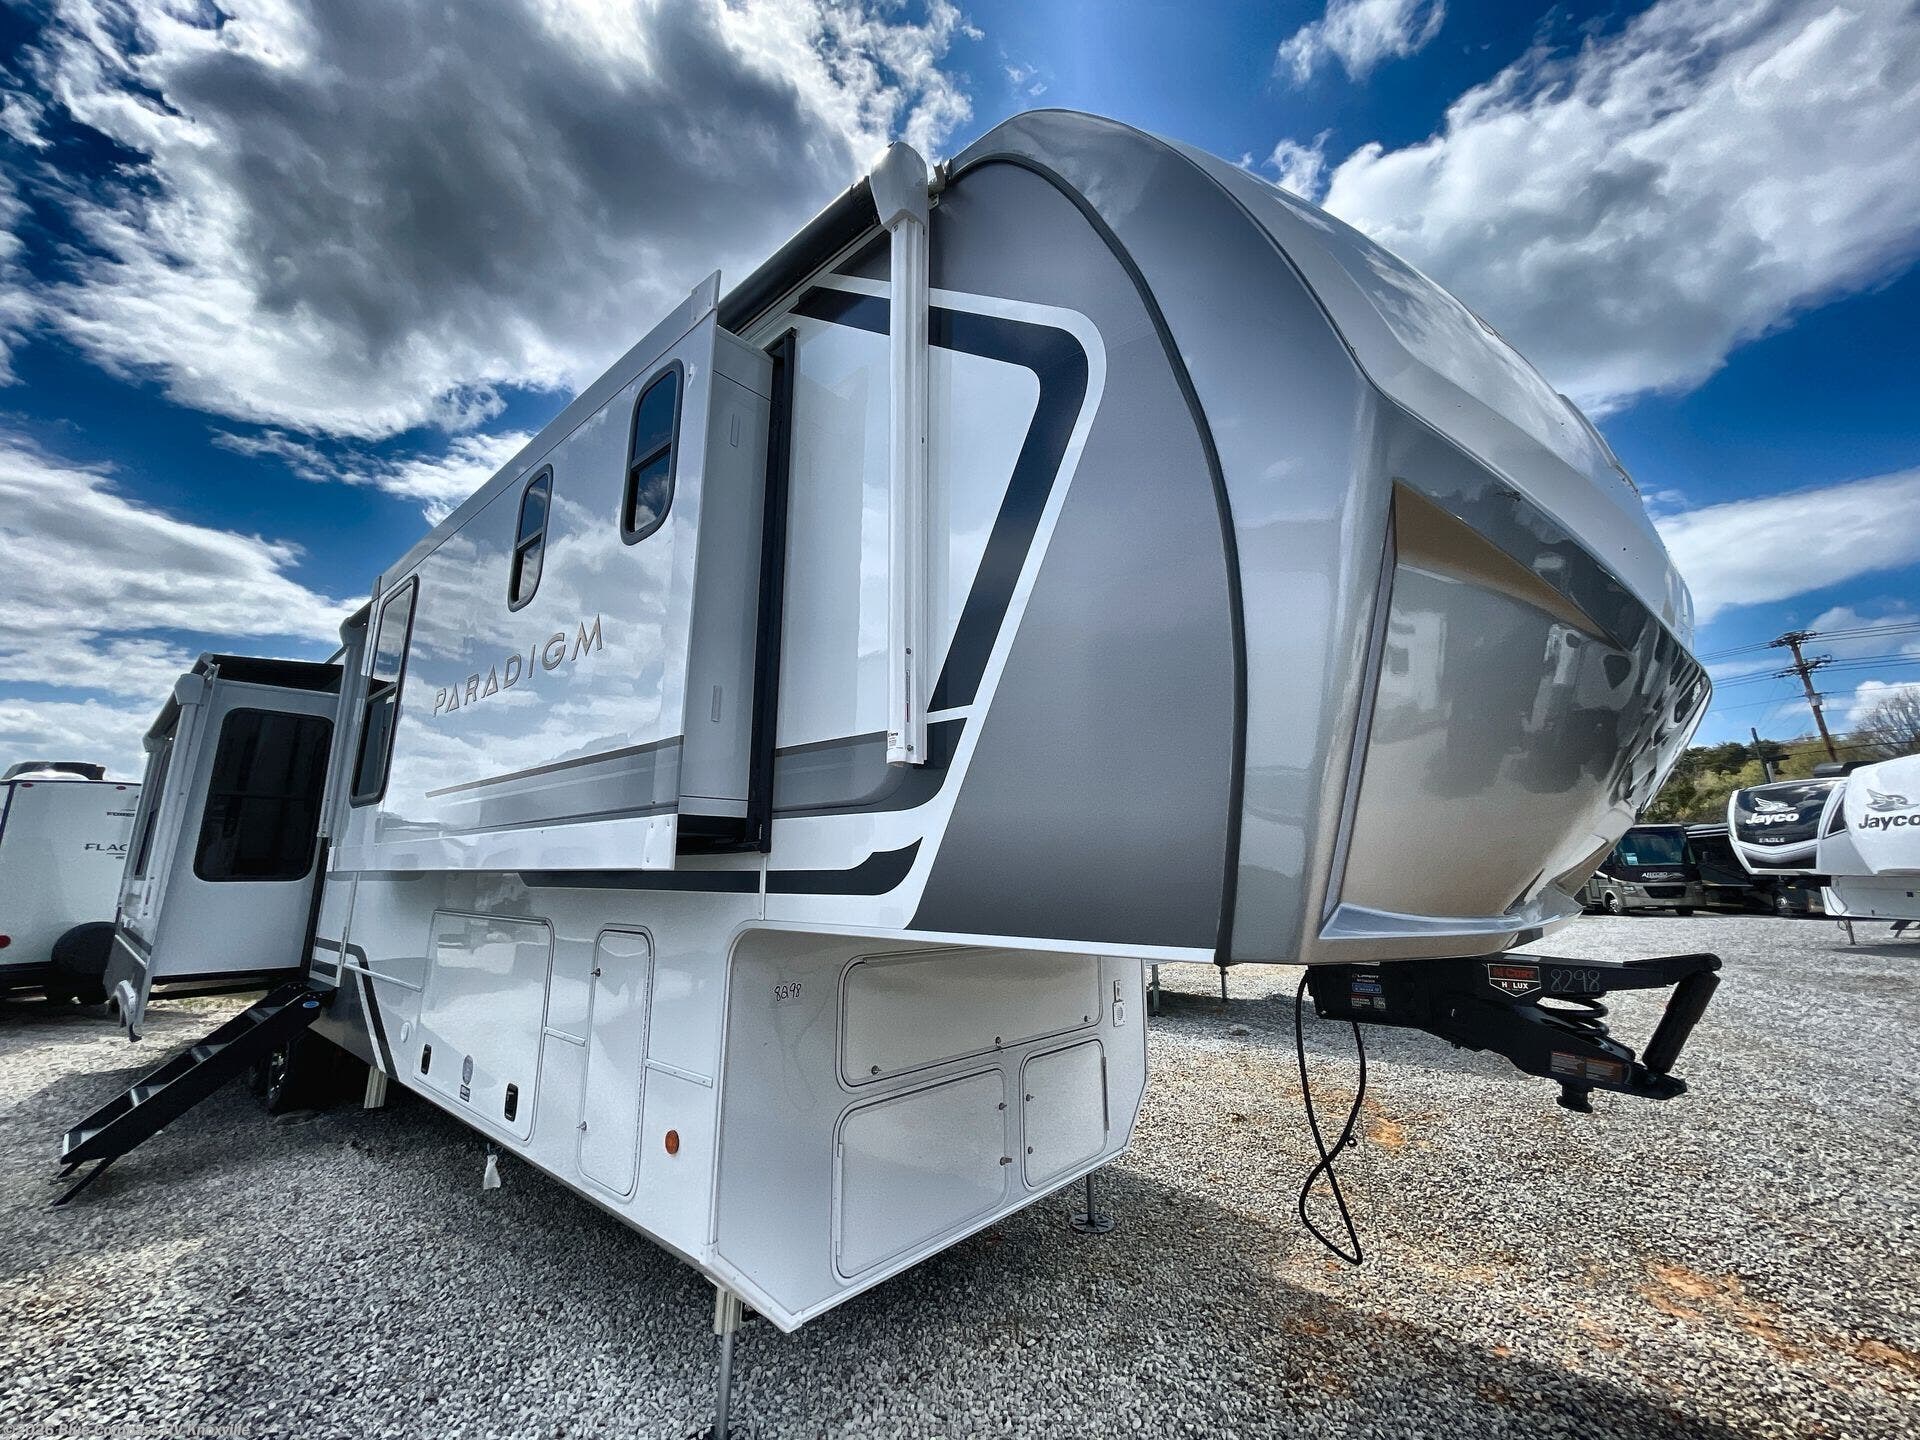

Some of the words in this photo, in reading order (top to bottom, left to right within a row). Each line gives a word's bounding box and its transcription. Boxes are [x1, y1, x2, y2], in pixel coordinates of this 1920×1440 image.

[433, 613, 604, 718] PARADIGM
[1745, 812, 1800, 825] Jayco
[1858, 814, 1920, 831] Jayco
[1550, 968, 1600, 993] 8298
[774, 983, 802, 1001] 8298
